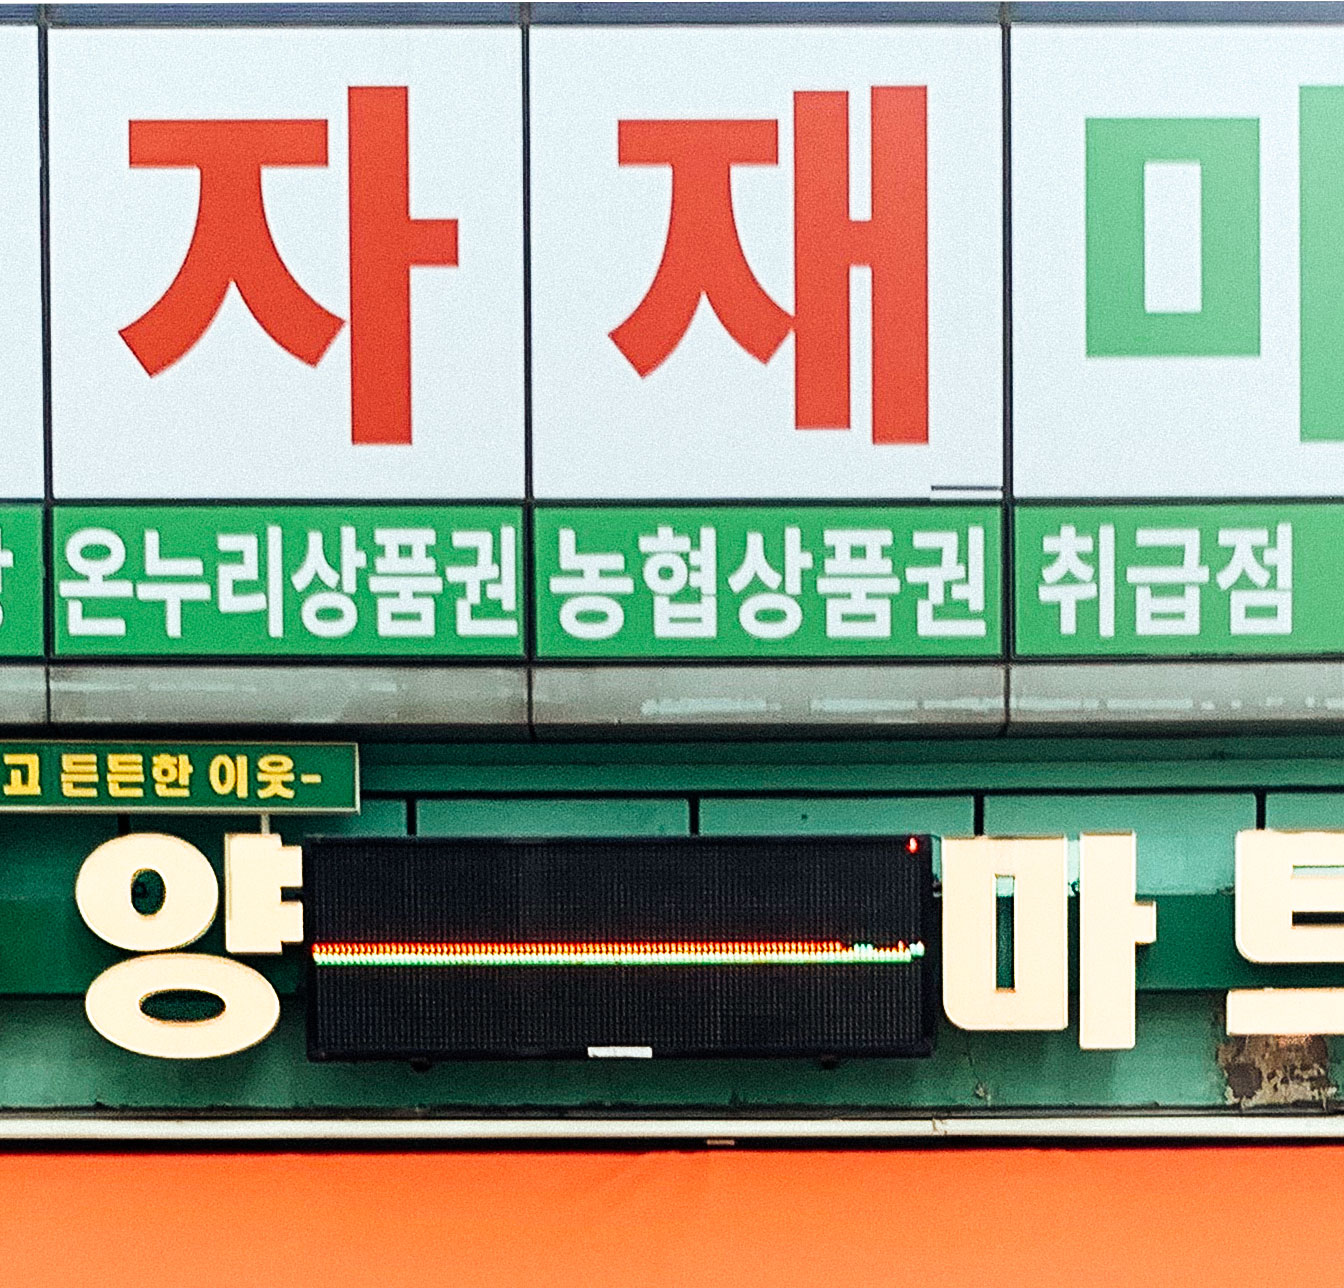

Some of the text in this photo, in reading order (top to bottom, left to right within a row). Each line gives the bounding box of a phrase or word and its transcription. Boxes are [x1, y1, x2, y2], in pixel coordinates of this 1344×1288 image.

[57, 525, 518, 638] 온누리상품권
[550, 524, 986, 638] 농협상품권
[1037, 522, 1295, 635] 취급점
[61, 752, 193, 798] 든든한
